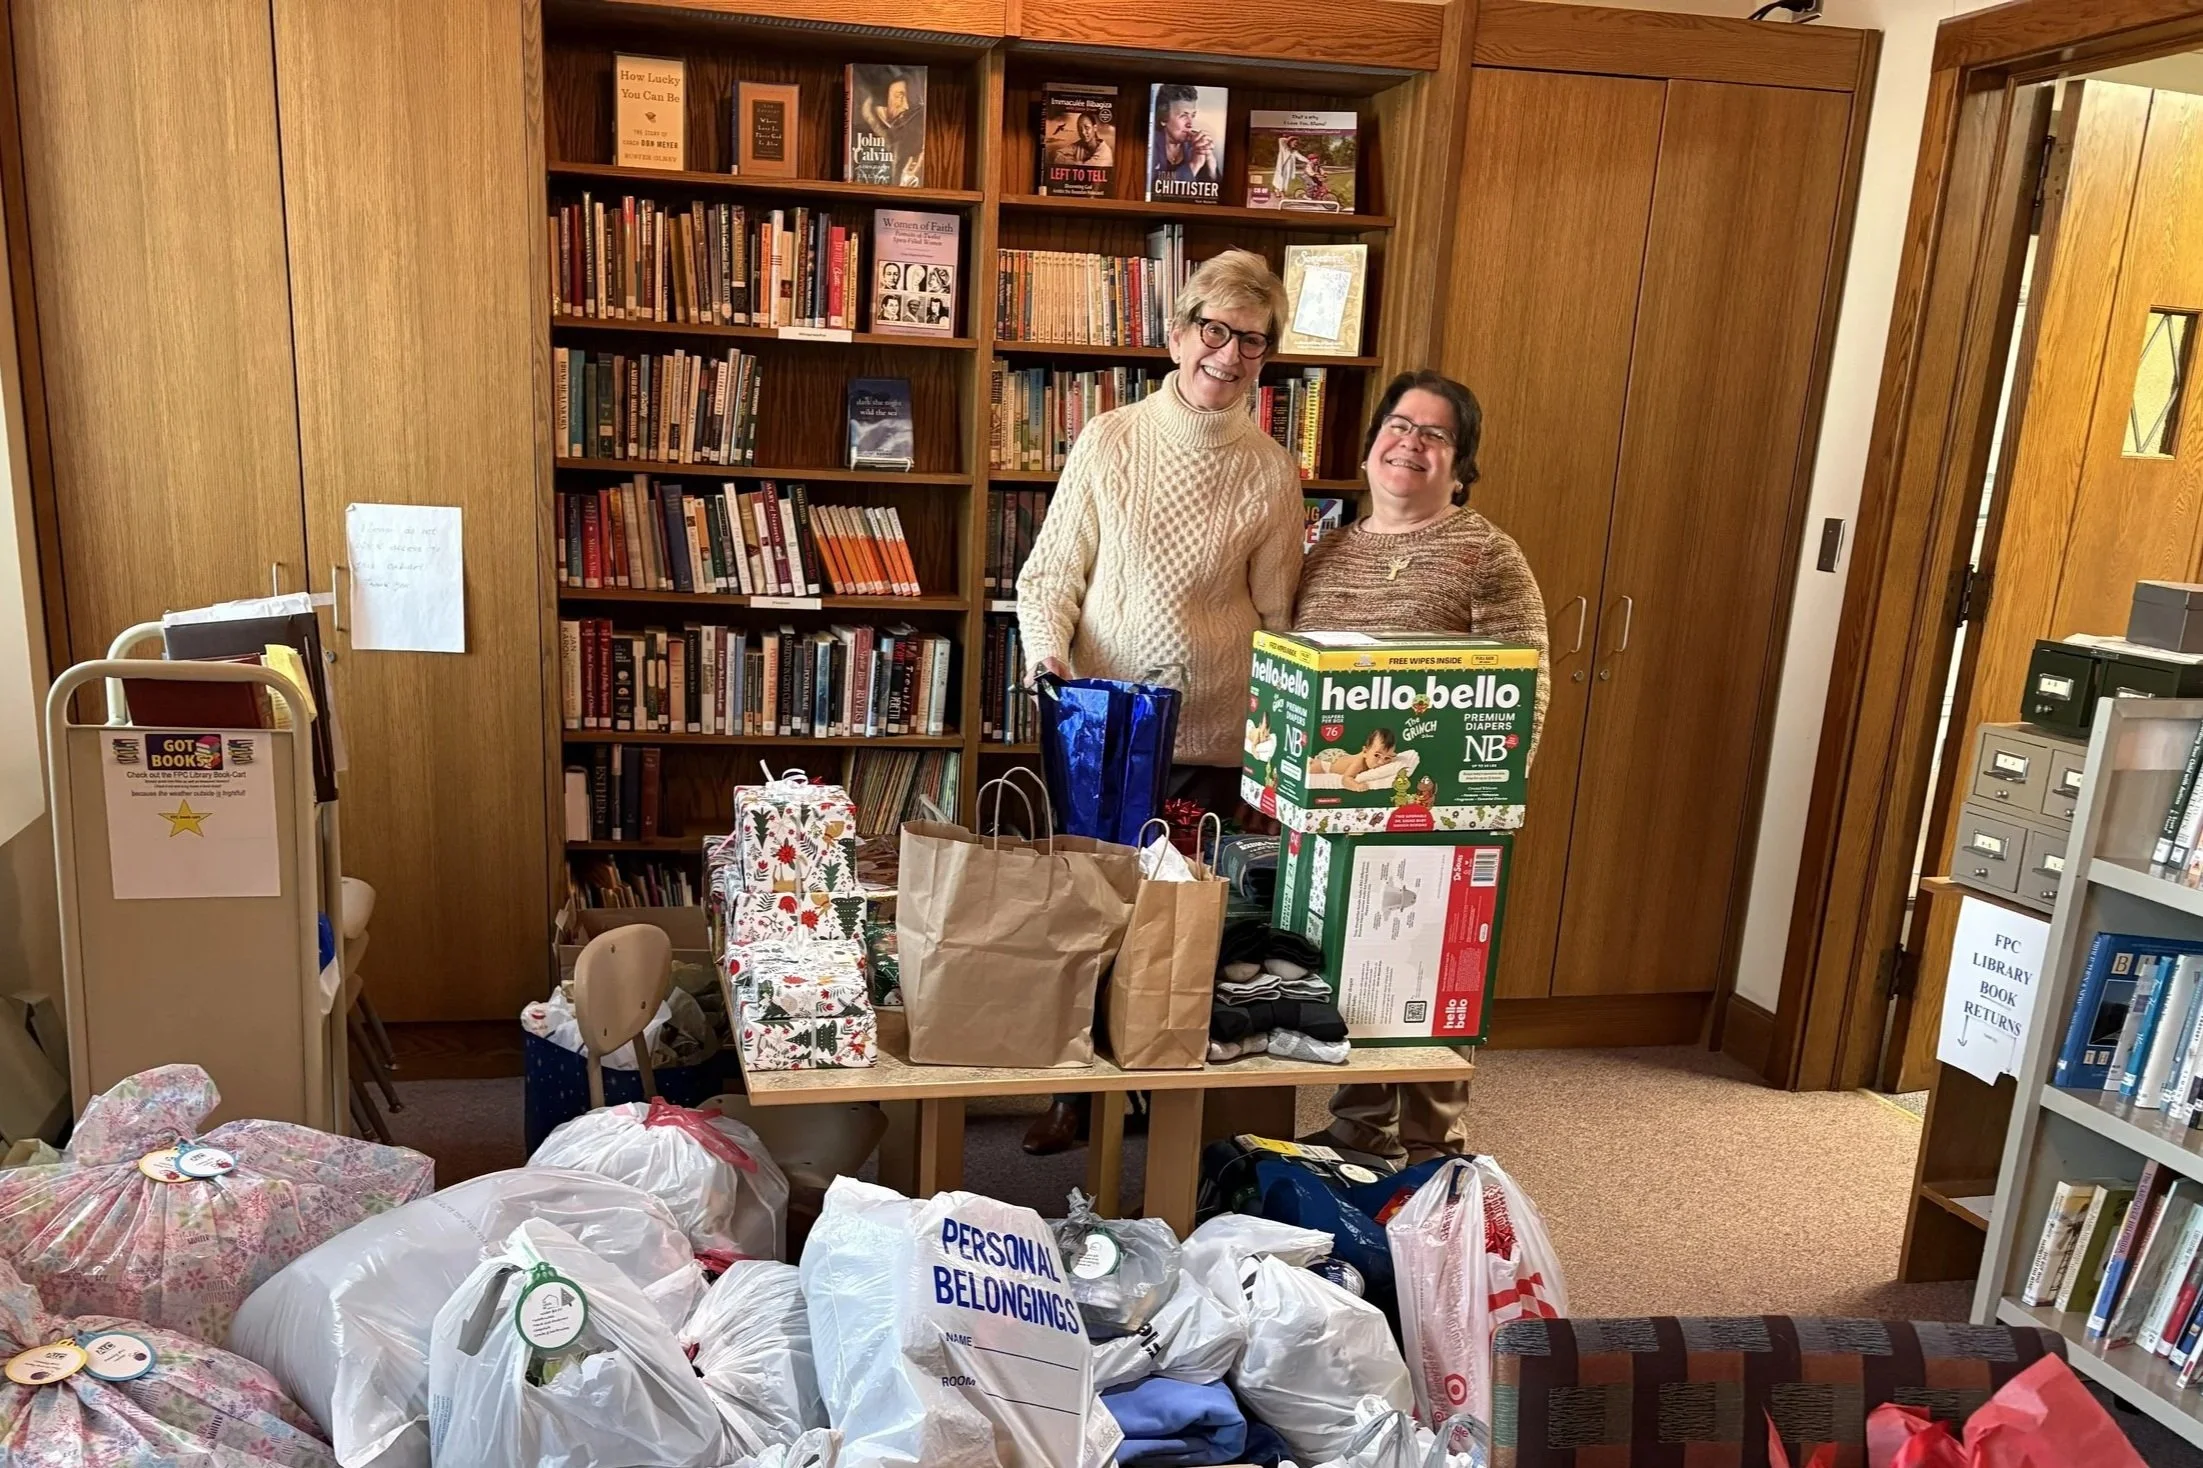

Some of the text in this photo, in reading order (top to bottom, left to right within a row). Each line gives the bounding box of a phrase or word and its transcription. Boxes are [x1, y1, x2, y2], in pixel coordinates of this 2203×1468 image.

[620, 70, 681, 87] How Lucky
[621, 89, 680, 103] You Can Be
[657, 141, 679, 149] MEYER
[857, 132, 885, 149] John
[852, 147, 894, 164] Calvin
[1050, 167, 1107, 183] LEFT TO TELL
[1155, 180, 1219, 197] CHITTISTER
[883, 218, 953, 232] Women of Faith
[860, 408, 874, 416] wild
[765, 481, 774, 503] MARY
[771, 512, 781, 542] Nazareth
[561, 627, 569, 658] KARON
[783, 639, 793, 665] SKELETON
[1389, 656, 1463, 665] FREE WIPES INSIDE
[1251, 653, 1309, 699] hello bello
[900, 665, 914, 711] Trouble
[1321, 675, 1520, 711] hello bello
[854, 689, 865, 721] RIVERS
[1405, 717, 1420, 727] The
[1464, 713, 1515, 721] PREMIUM
[1326, 728, 1338, 736] 76
[1402, 720, 1437, 741] GRINCH
[1465, 722, 1512, 730] DIAPERS
[163, 739, 195, 752] GOT
[1284, 724, 1303, 757] NB
[1463, 735, 1508, 762] NB
[2190, 744, 2200, 758] Your
[152, 754, 213, 768] BOOKS?
[2185, 757, 2195, 773] Child
[189, 771, 212, 779] Library
[2181, 773, 2190, 786] with
[595, 766, 606, 814] ESTHER
[1995, 933, 2021, 953] FPC
[1972, 952, 2033, 985] LIBRARY
[1980, 981, 2018, 1007] BOOK
[1444, 998, 1457, 1029] hello
[1455, 998, 1468, 1029] bello
[1964, 1001, 2022, 1036] RETURNS
[2116, 1171, 2152, 1254] The CAREGIVER HELPBOOK
[942, 1217, 1061, 1283] PERSONAL
[933, 1266, 1079, 1334] BELONGINGS
[946, 1332, 972, 1346] NAME
[942, 1375, 976, 1387] ROOM
